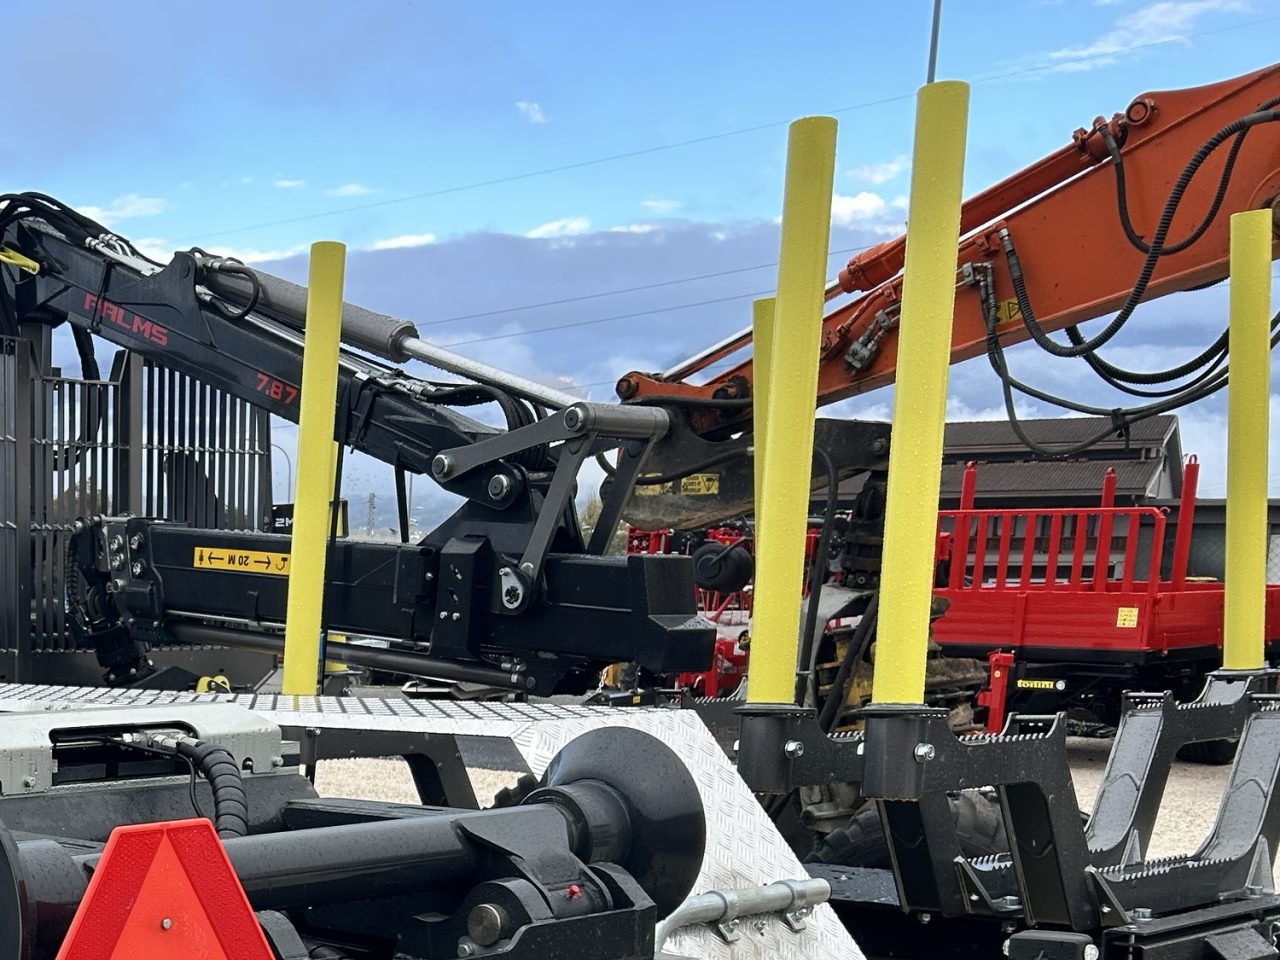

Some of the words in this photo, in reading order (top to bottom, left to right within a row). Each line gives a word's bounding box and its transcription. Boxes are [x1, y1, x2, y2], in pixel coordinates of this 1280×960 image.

[84, 291, 169, 346] PALMS
[256, 371, 298, 405] 7.87
[228, 555, 235, 564] M
[238, 556, 249, 566] 20
